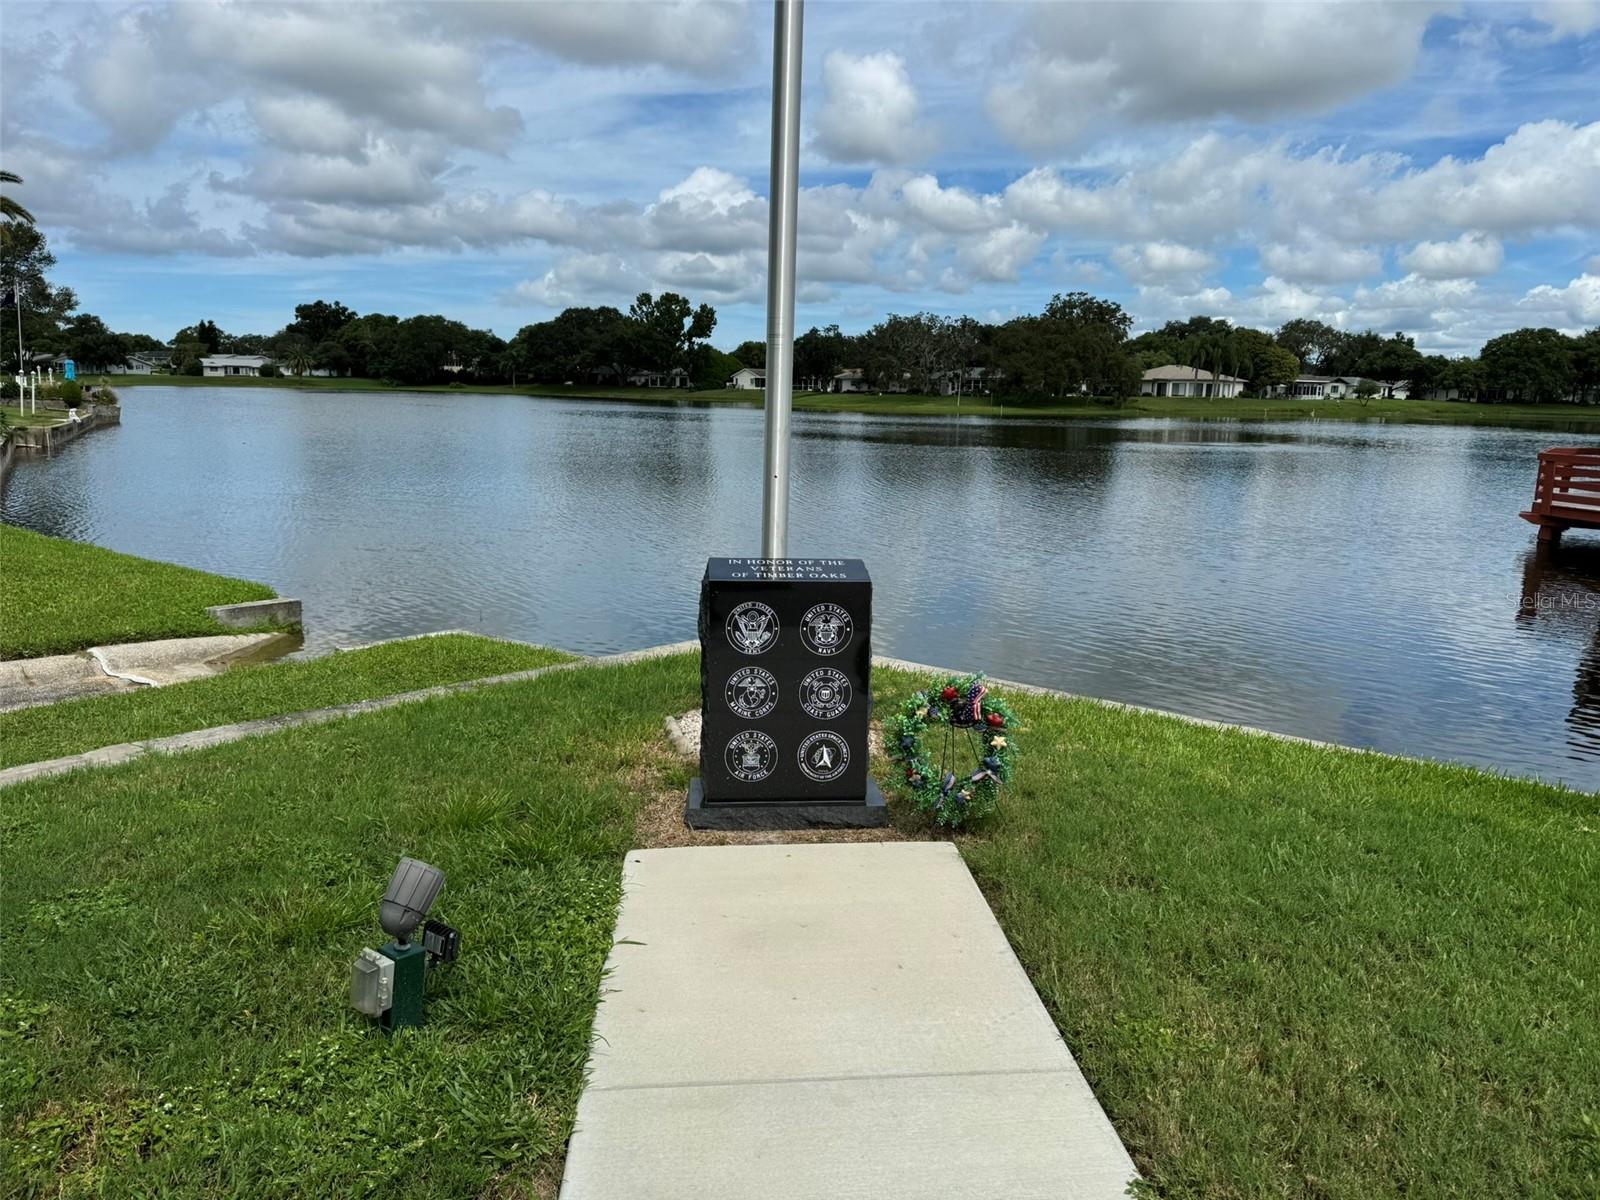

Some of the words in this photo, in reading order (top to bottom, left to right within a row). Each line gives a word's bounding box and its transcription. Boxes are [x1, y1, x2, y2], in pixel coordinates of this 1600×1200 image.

[805, 605, 826, 622] UNITED
[829, 605, 850, 622] STATES
[729, 668, 750, 685] UNITED
[754, 668, 775, 685] STATES
[803, 670, 824, 687] UNITED
[827, 670, 849, 687] STATES
[729, 701, 752, 717] MARINE
[755, 702, 774, 716] CORPS
[804, 702, 823, 716] COAST
[826, 703, 846, 718] GUARD
[729, 732, 750, 749] UNITED
[753, 732, 774, 749] STATES
[734, 770, 745, 779] AIR
[748, 770, 769, 780] FORCE
